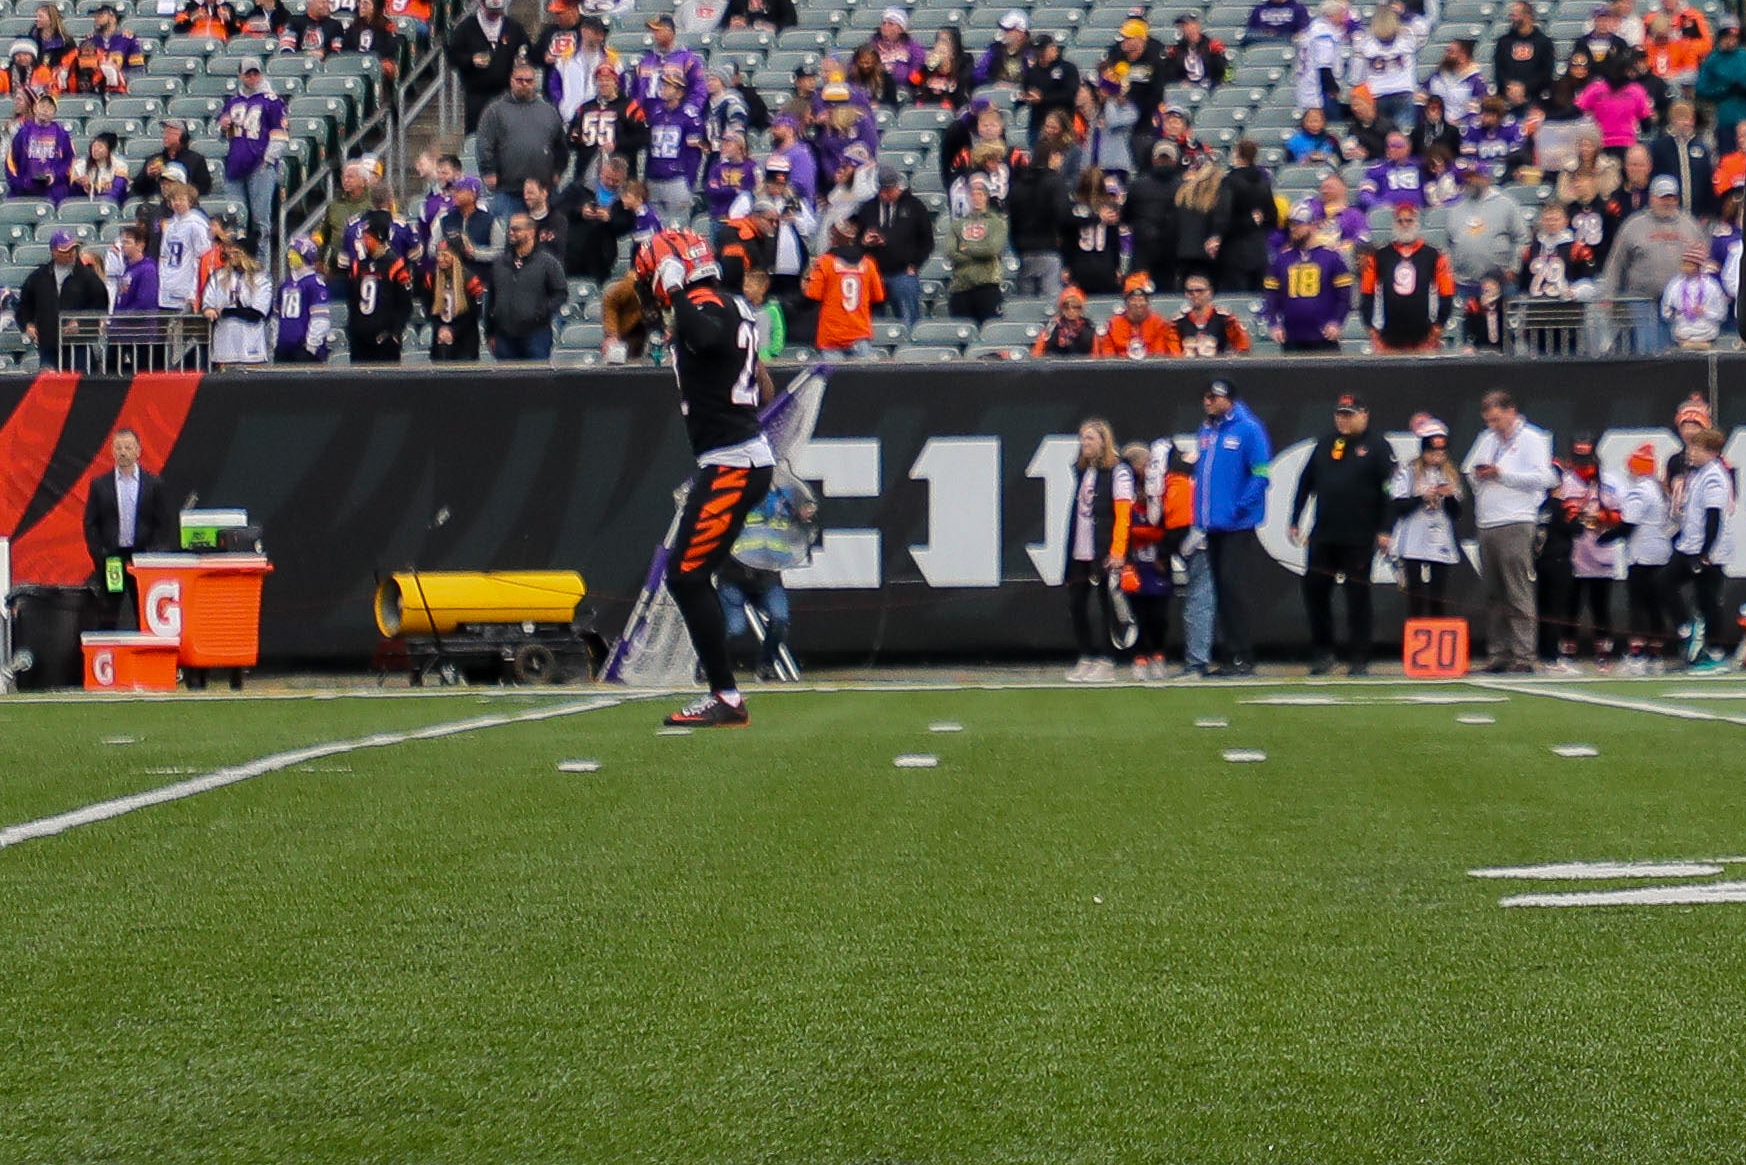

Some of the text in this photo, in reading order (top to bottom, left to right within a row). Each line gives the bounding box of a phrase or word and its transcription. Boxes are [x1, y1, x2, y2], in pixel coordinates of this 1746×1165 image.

[583, 112, 617, 147] 55
[359, 275, 376, 315] 9
[840, 272, 861, 312] 9
[1287, 262, 1321, 298] 18
[1393, 262, 1416, 295] 9
[145, 580, 181, 639] G
[1411, 628, 1459, 669] 20
[93, 651, 114, 687] G
